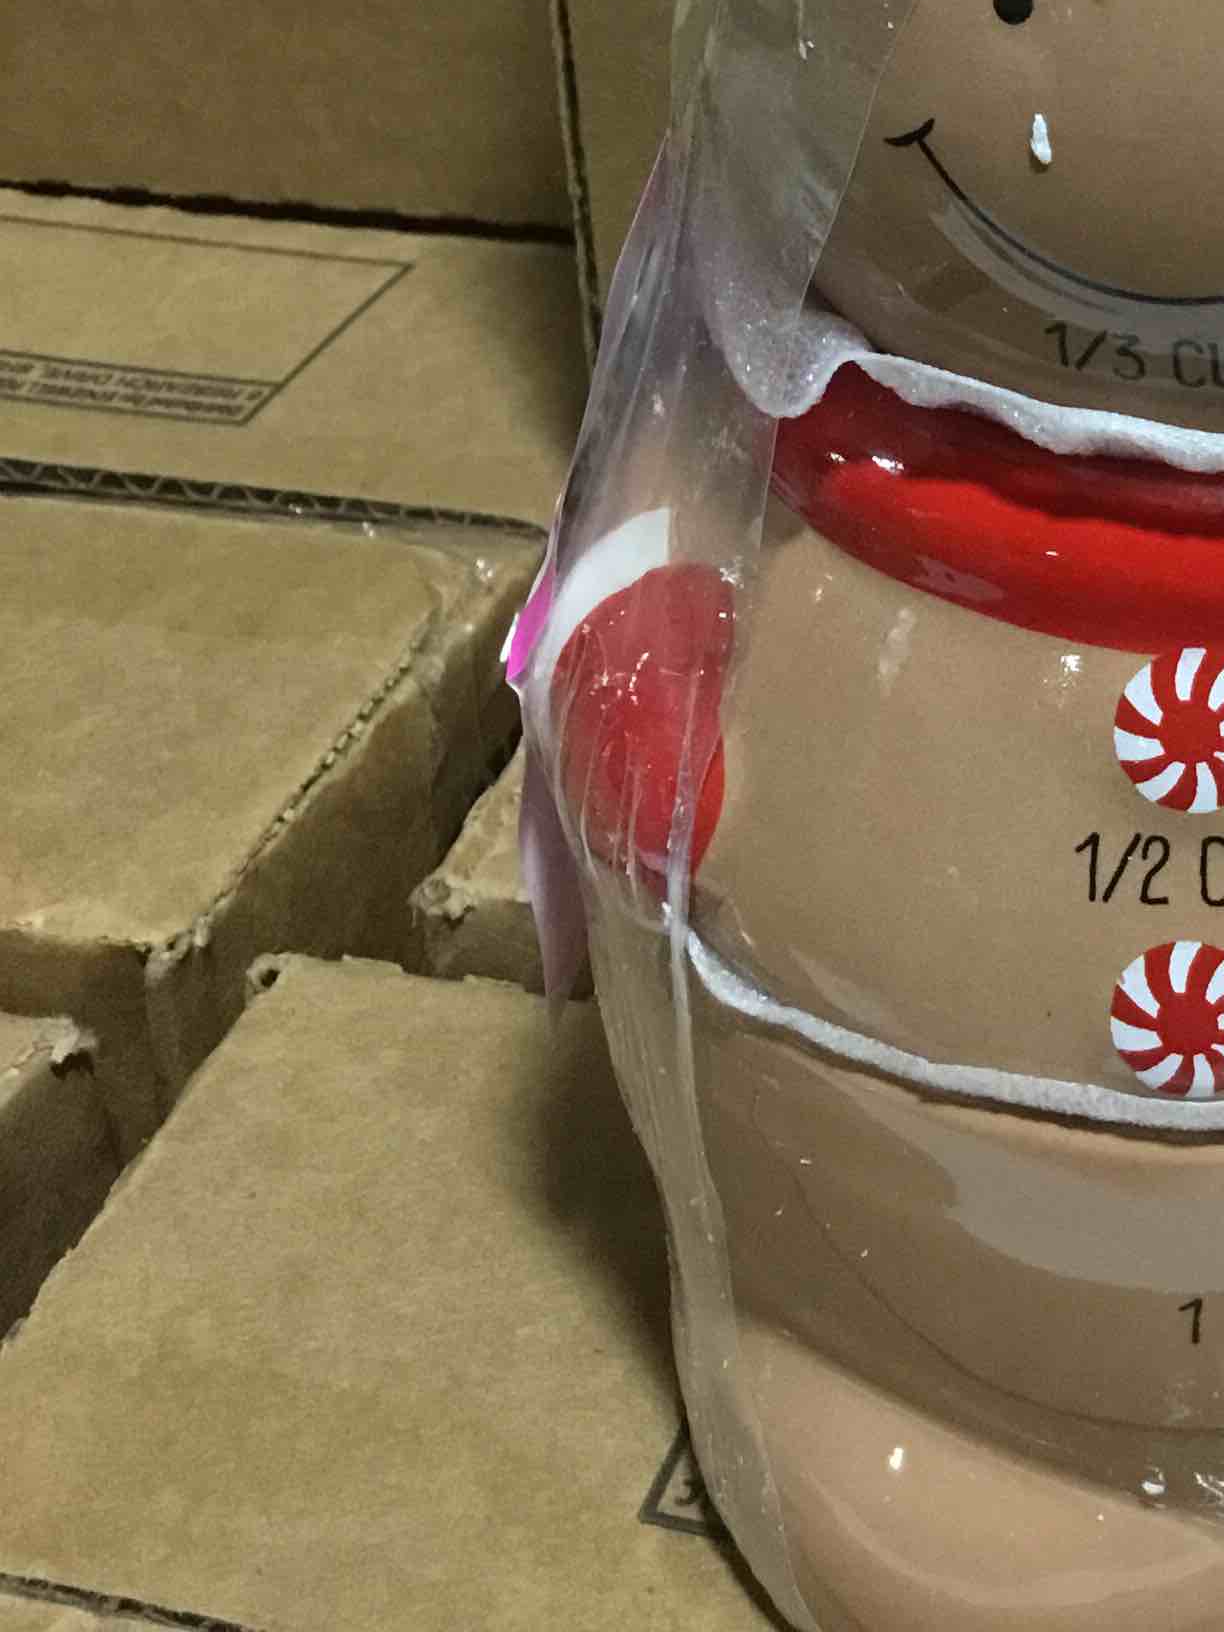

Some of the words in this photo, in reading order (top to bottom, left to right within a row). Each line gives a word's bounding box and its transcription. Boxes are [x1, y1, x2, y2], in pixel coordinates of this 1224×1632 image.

[1044, 321, 1146, 381] 1/3
[1075, 831, 1170, 905] 1/2
[1177, 1298, 1203, 1344] 1
